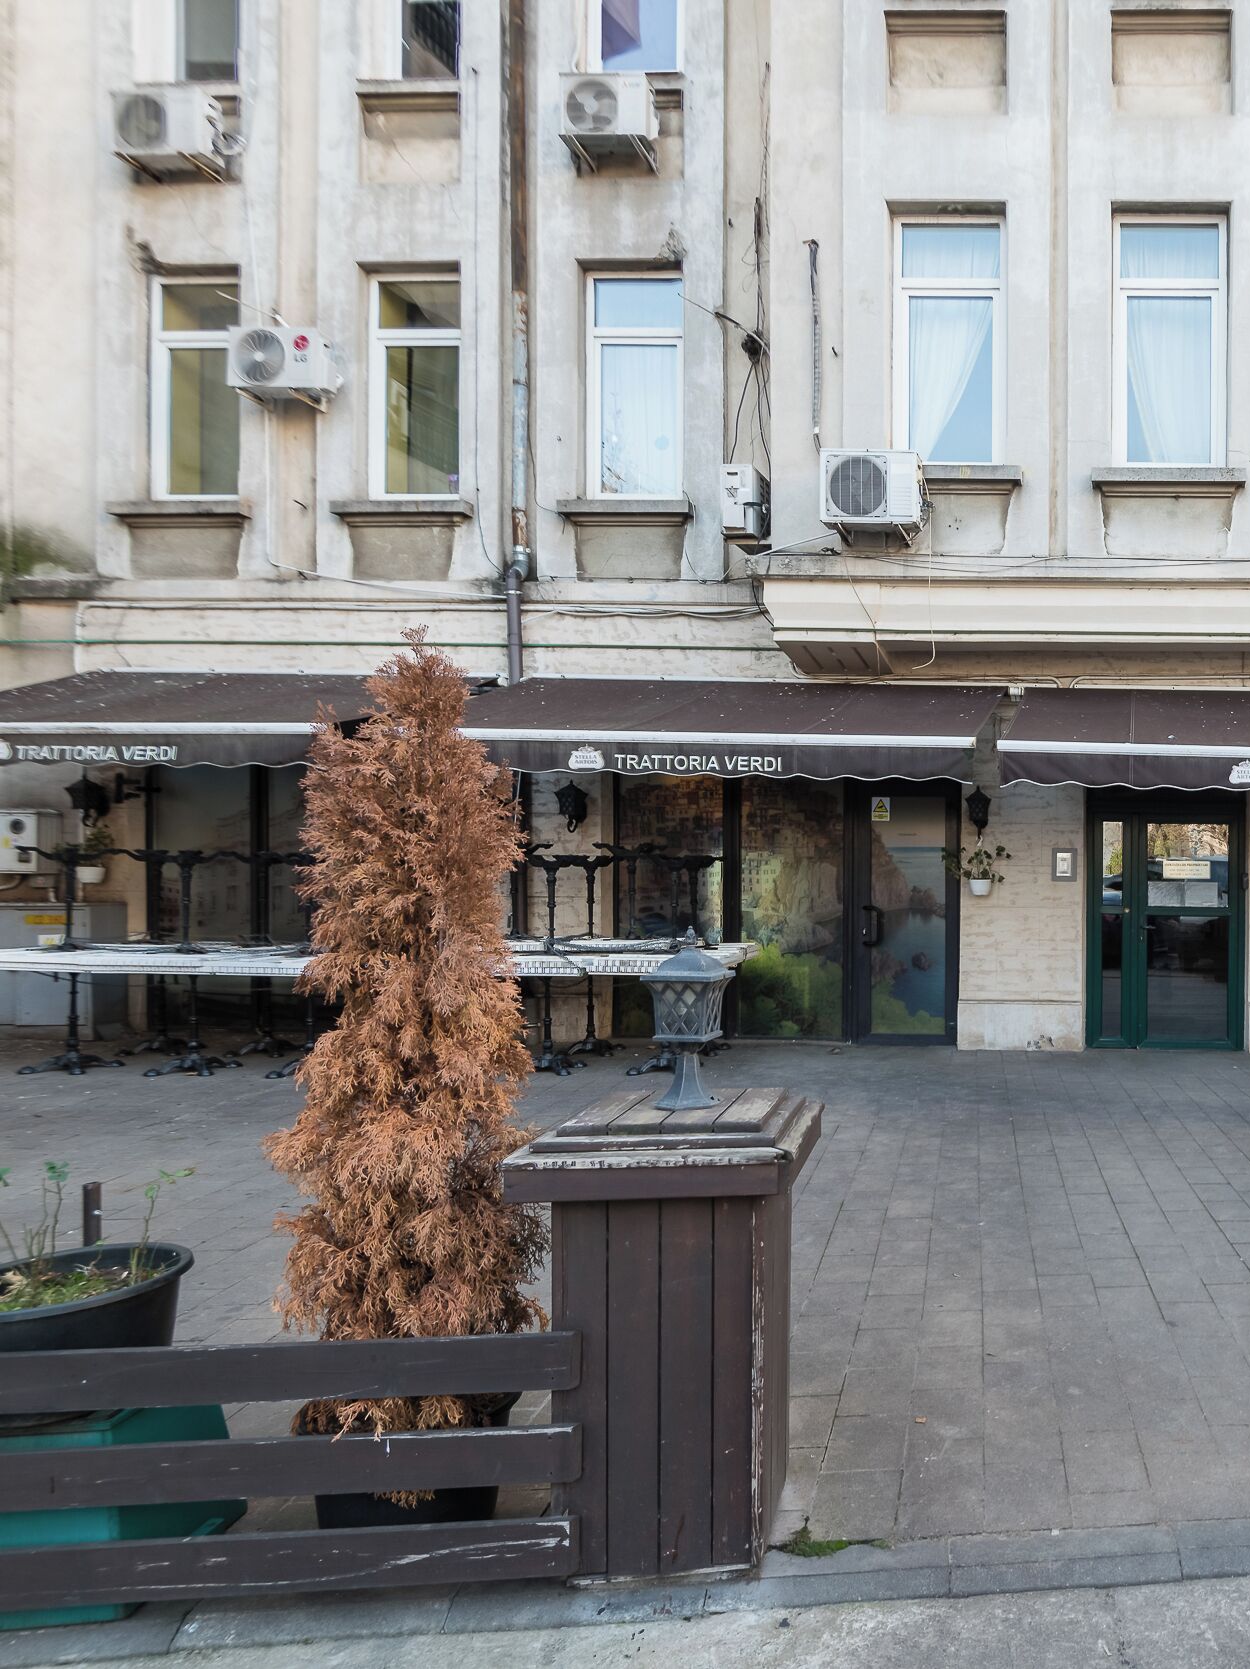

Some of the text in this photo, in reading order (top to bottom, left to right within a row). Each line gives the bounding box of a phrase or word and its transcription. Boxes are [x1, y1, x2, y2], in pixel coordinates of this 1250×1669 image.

[16, 745, 119, 760] TRATTORIA
[121, 745, 178, 760] VERDI
[614, 754, 783, 772] TRATTORIA VERDI
